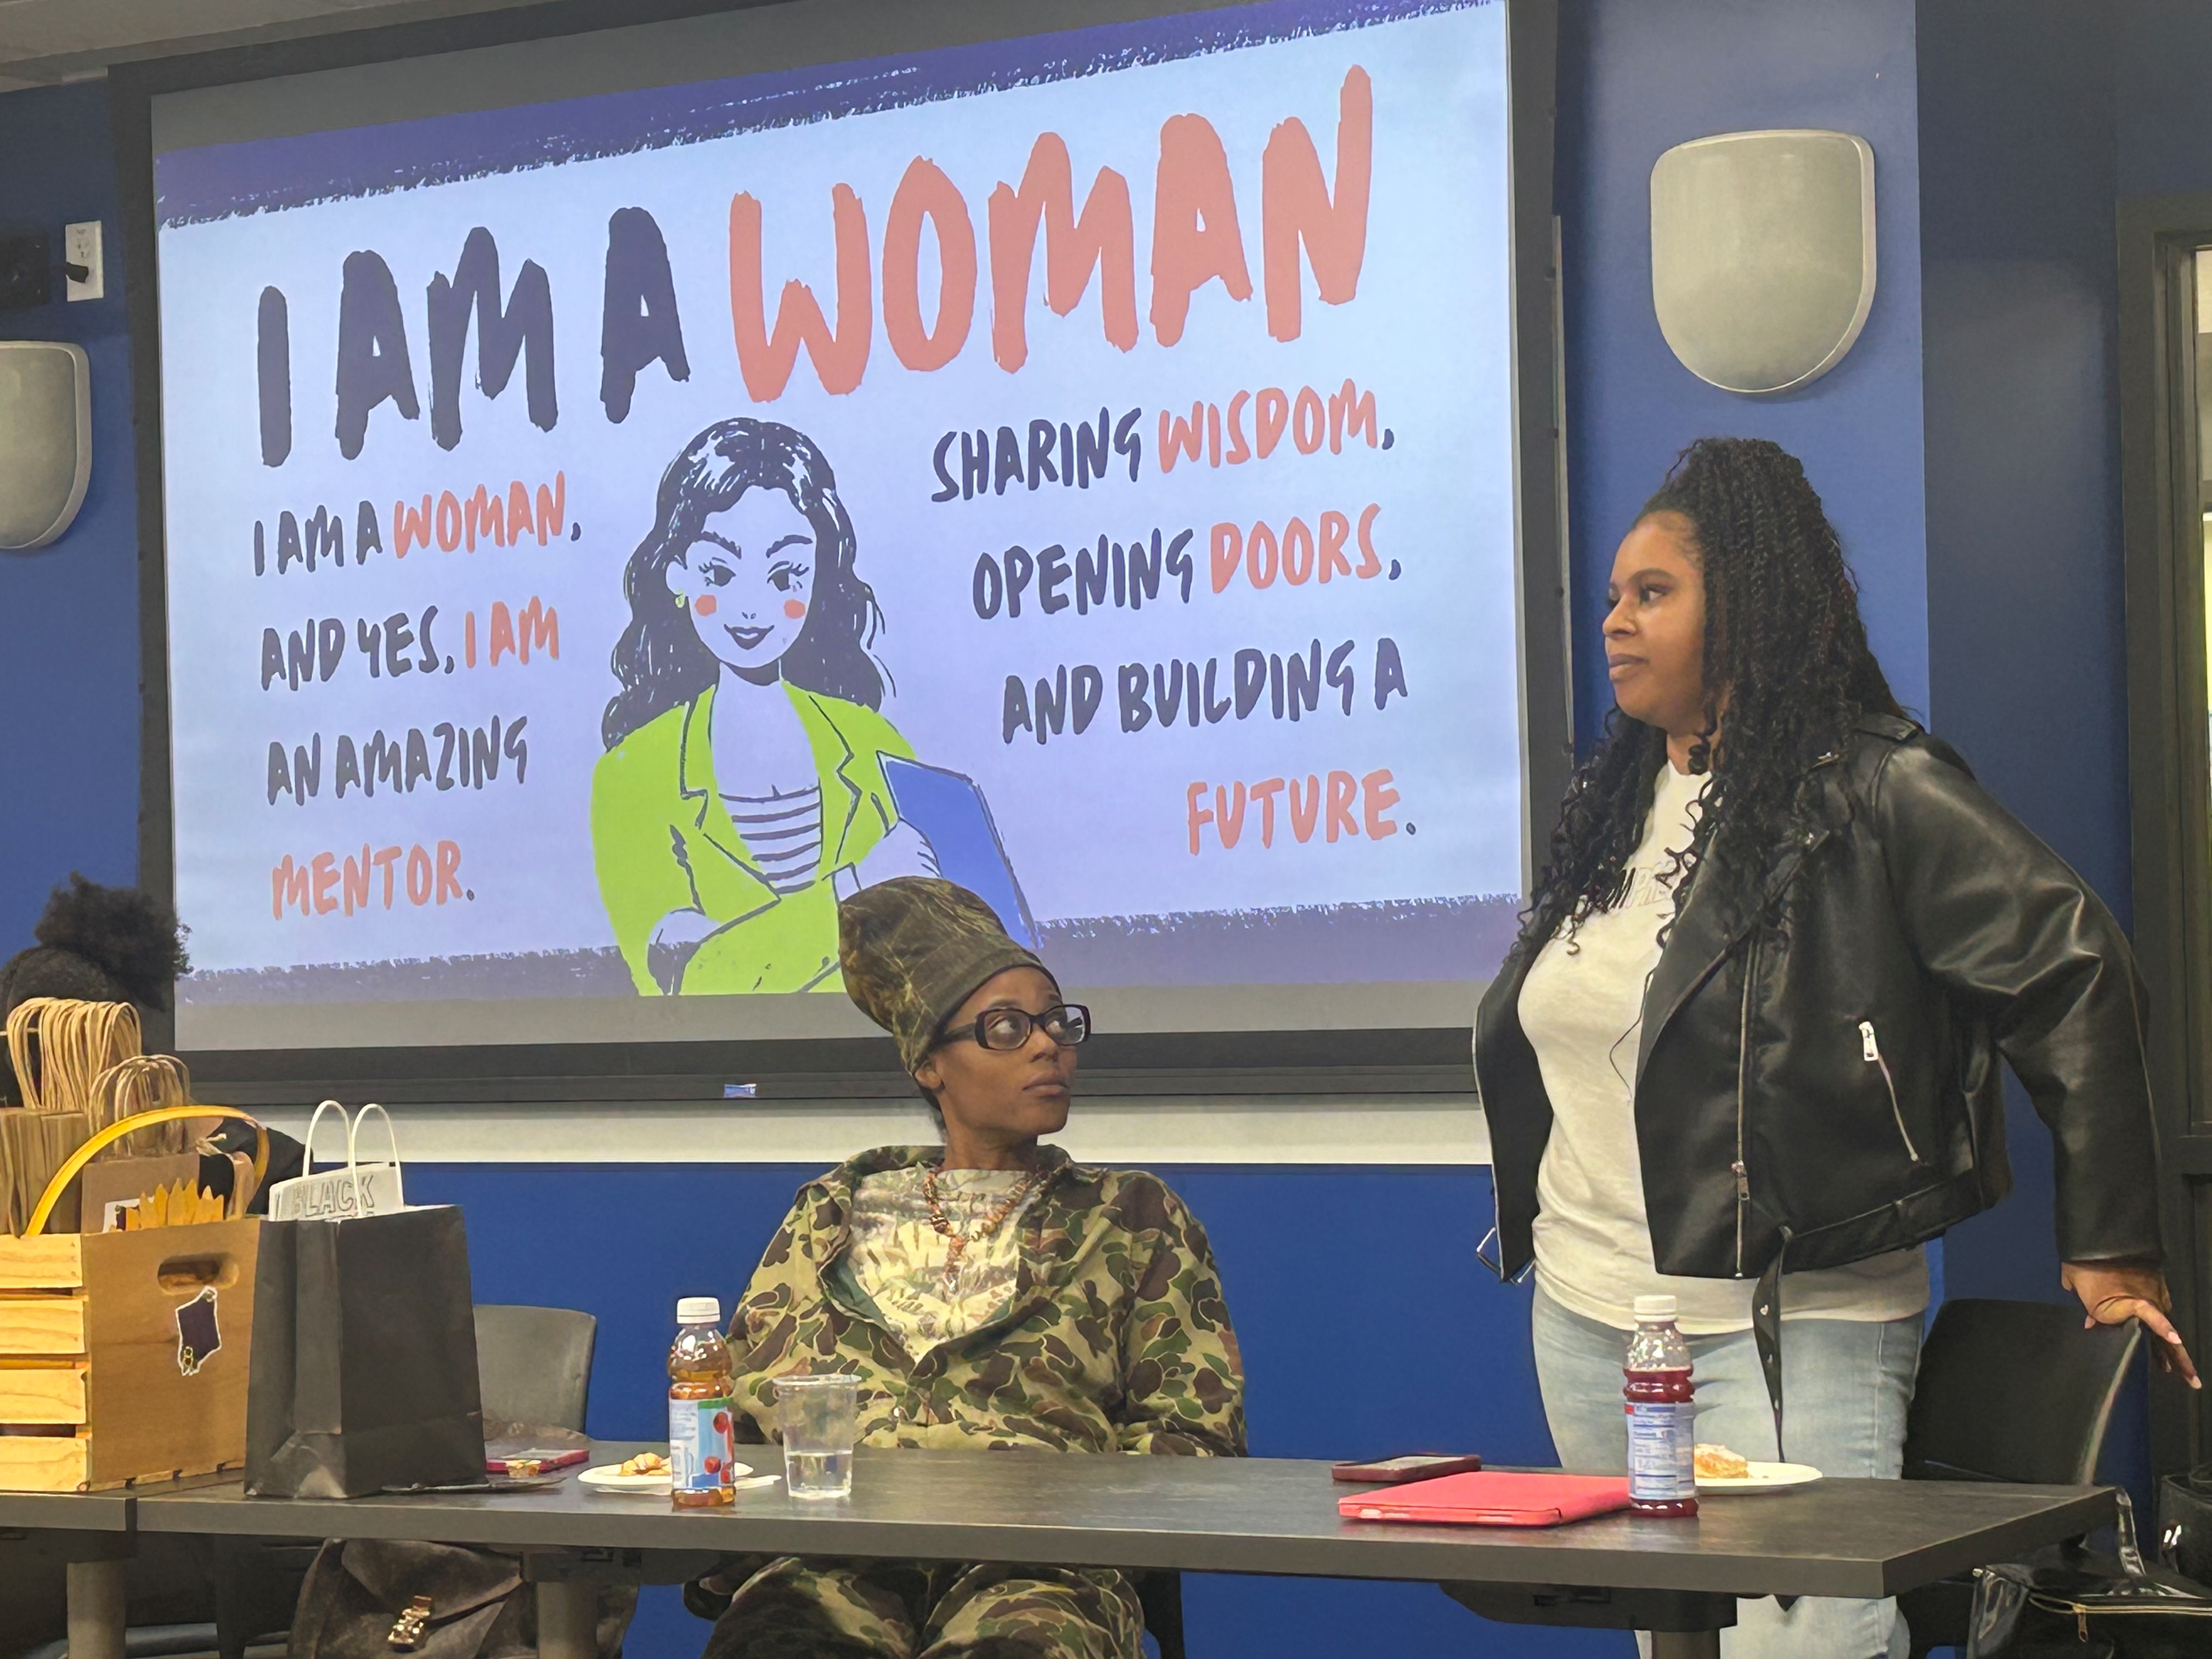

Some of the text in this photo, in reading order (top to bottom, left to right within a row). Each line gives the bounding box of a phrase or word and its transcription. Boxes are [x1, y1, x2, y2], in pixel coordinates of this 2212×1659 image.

[257, 64, 1374, 468] I AM A WOMAN
[931, 378, 1395, 503] SHARING WISDOM,
[254, 470, 582, 577] I AM A WOMAN,
[972, 503, 1402, 620] OPENING DOORS,
[261, 595, 560, 692] AND YES, I AM
[1002, 637, 1408, 745] AND BUILDING A
[267, 714, 528, 806] AN AMAZING
[1186, 768, 1418, 856] FUTURE.
[271, 839, 476, 921] MENTOR.
